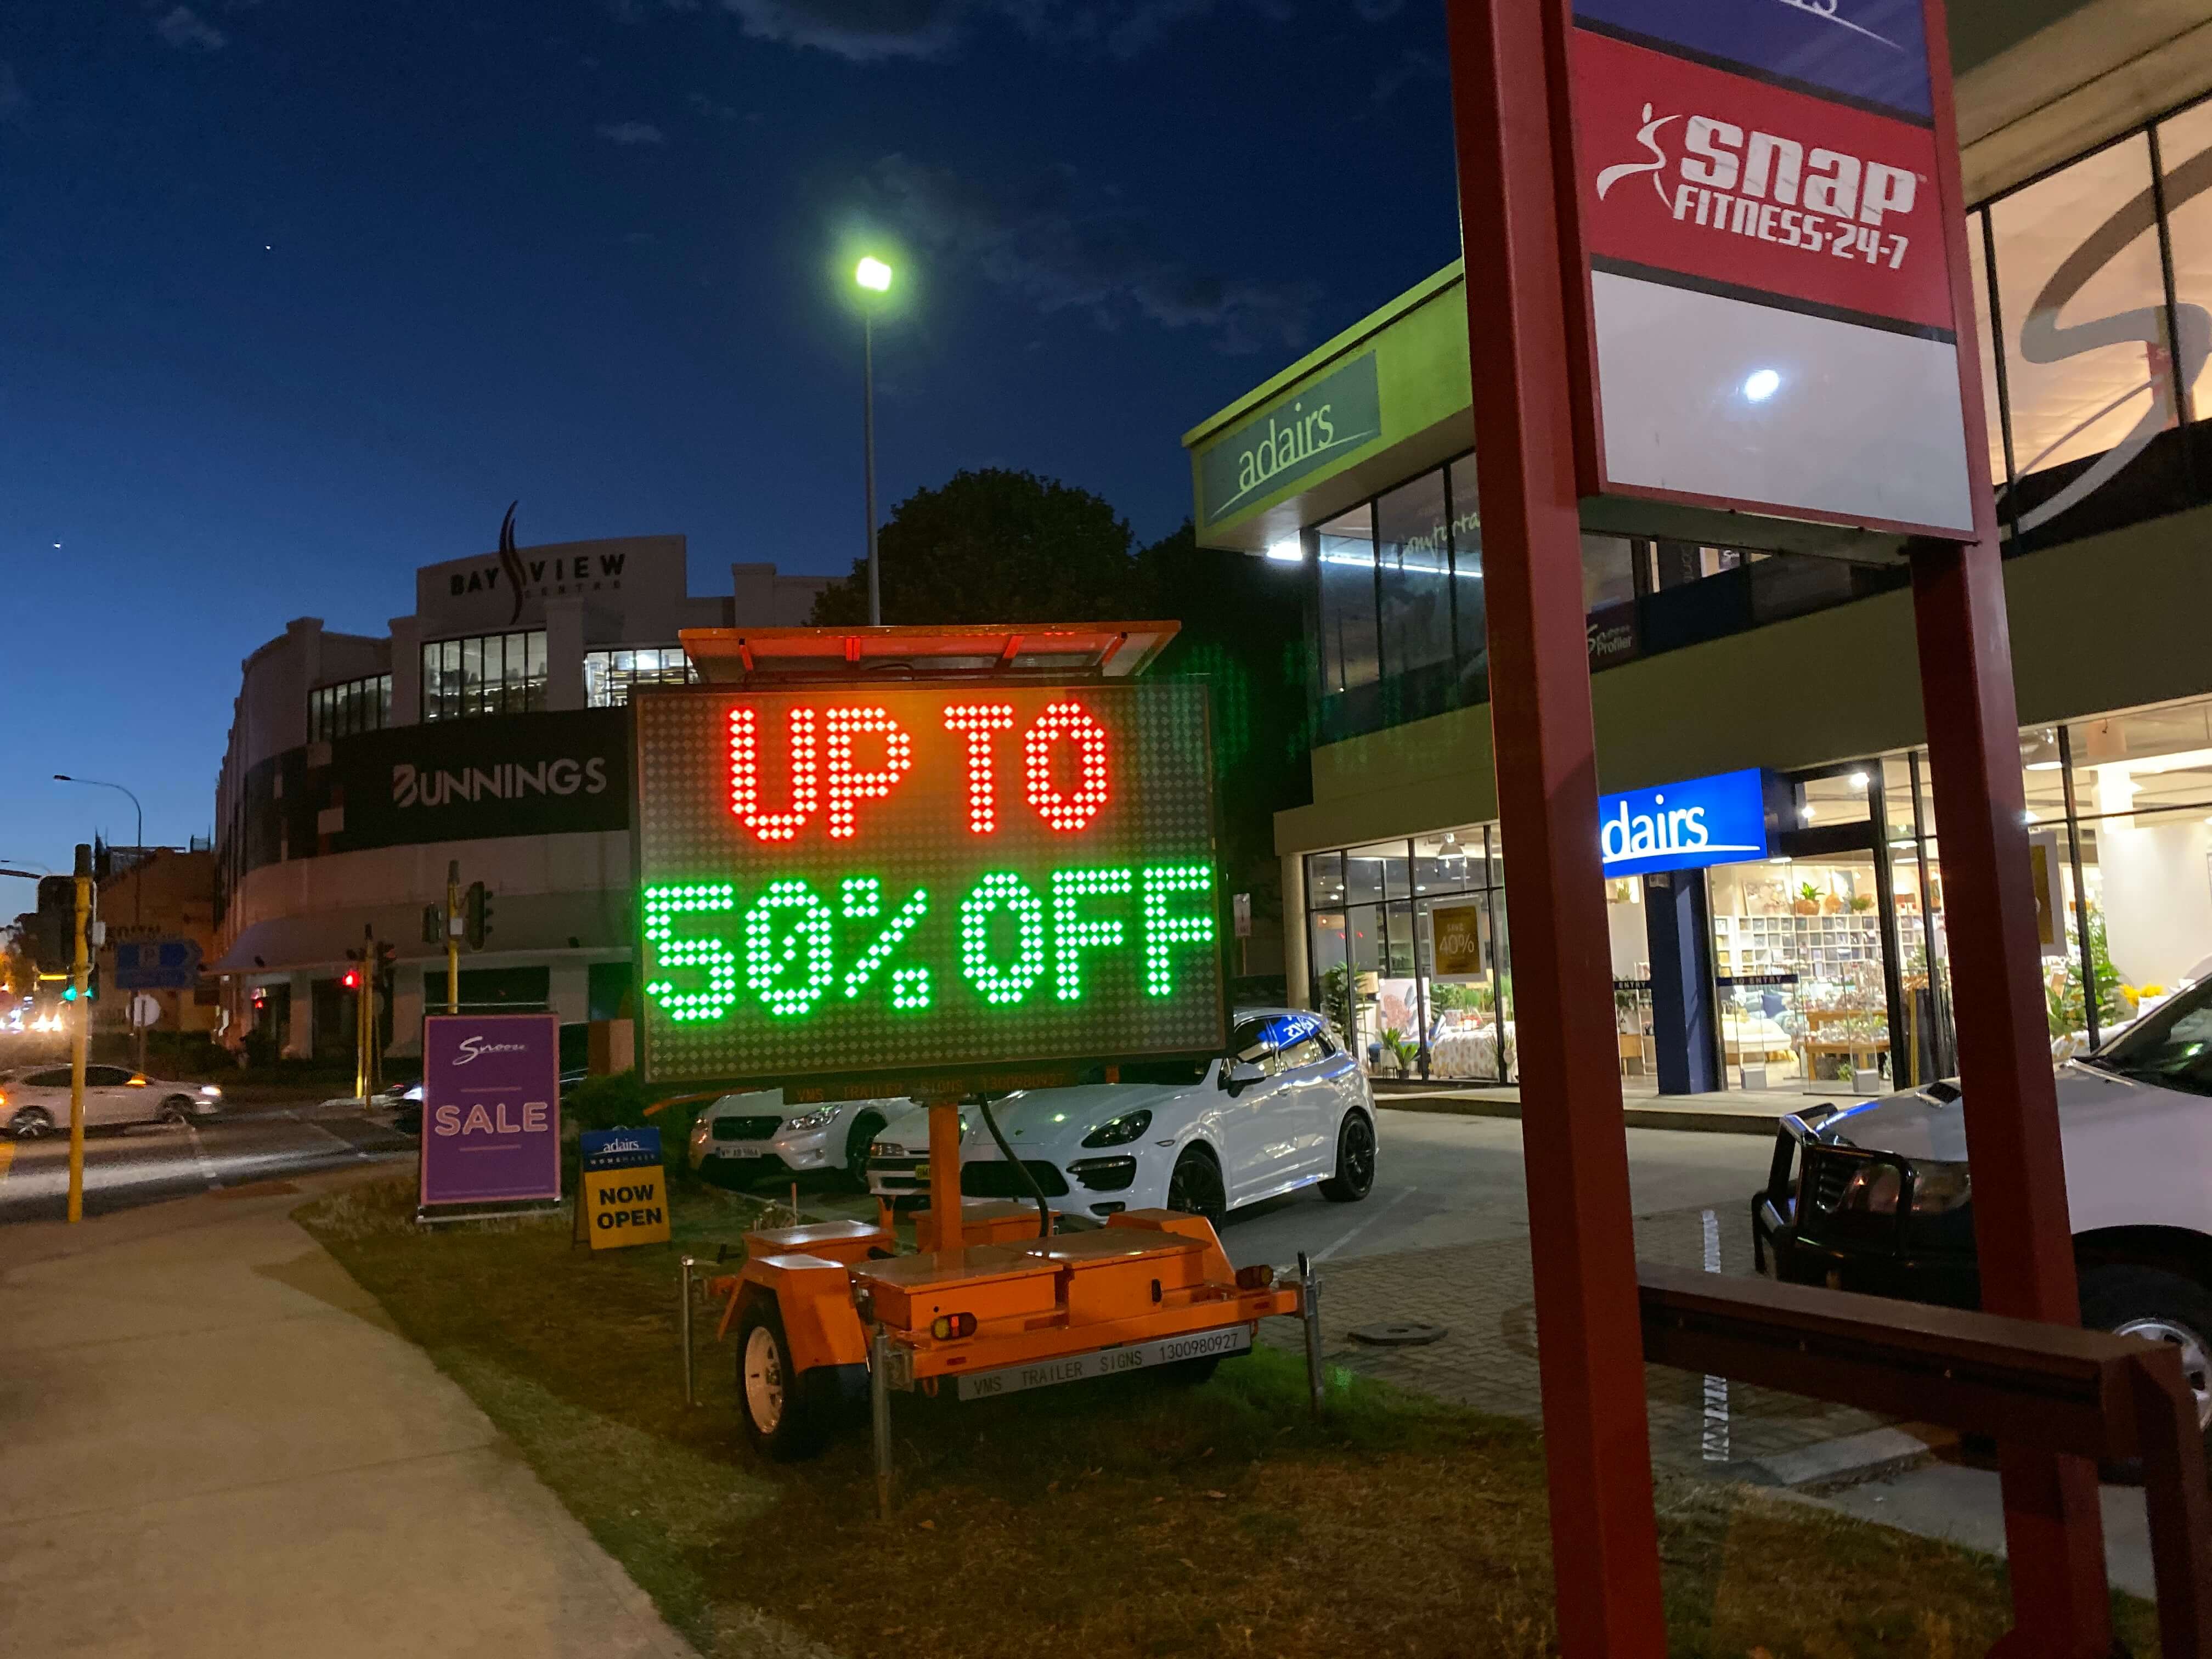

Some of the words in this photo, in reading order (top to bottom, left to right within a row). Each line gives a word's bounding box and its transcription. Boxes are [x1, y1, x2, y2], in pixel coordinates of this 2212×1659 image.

[1238, 402, 1333, 493] adairs
[450, 567, 499, 596] BAY
[530, 553, 625, 582] VIEW
[392, 757, 607, 808] BUNNINGS
[729, 706, 912, 841] UP
[943, 701, 1108, 831] TO
[1601, 793, 1708, 856] dairs
[643, 876, 930, 1023] 50%
[958, 863, 1216, 1005] OFF
[1439, 934, 1475, 955] 40%
[435, 1102, 548, 1136] SALE
[602, 1138, 639, 1152] adairs
[597, 1207, 662, 1229] OPEN
[599, 1184, 654, 1205] NOW
[973, 1376, 1002, 1396] VMS
[1020, 1361, 1084, 1387] TRAILER
[1100, 1350, 1143, 1374] SIGNS
[1159, 1332, 1239, 1361] 1300980927
